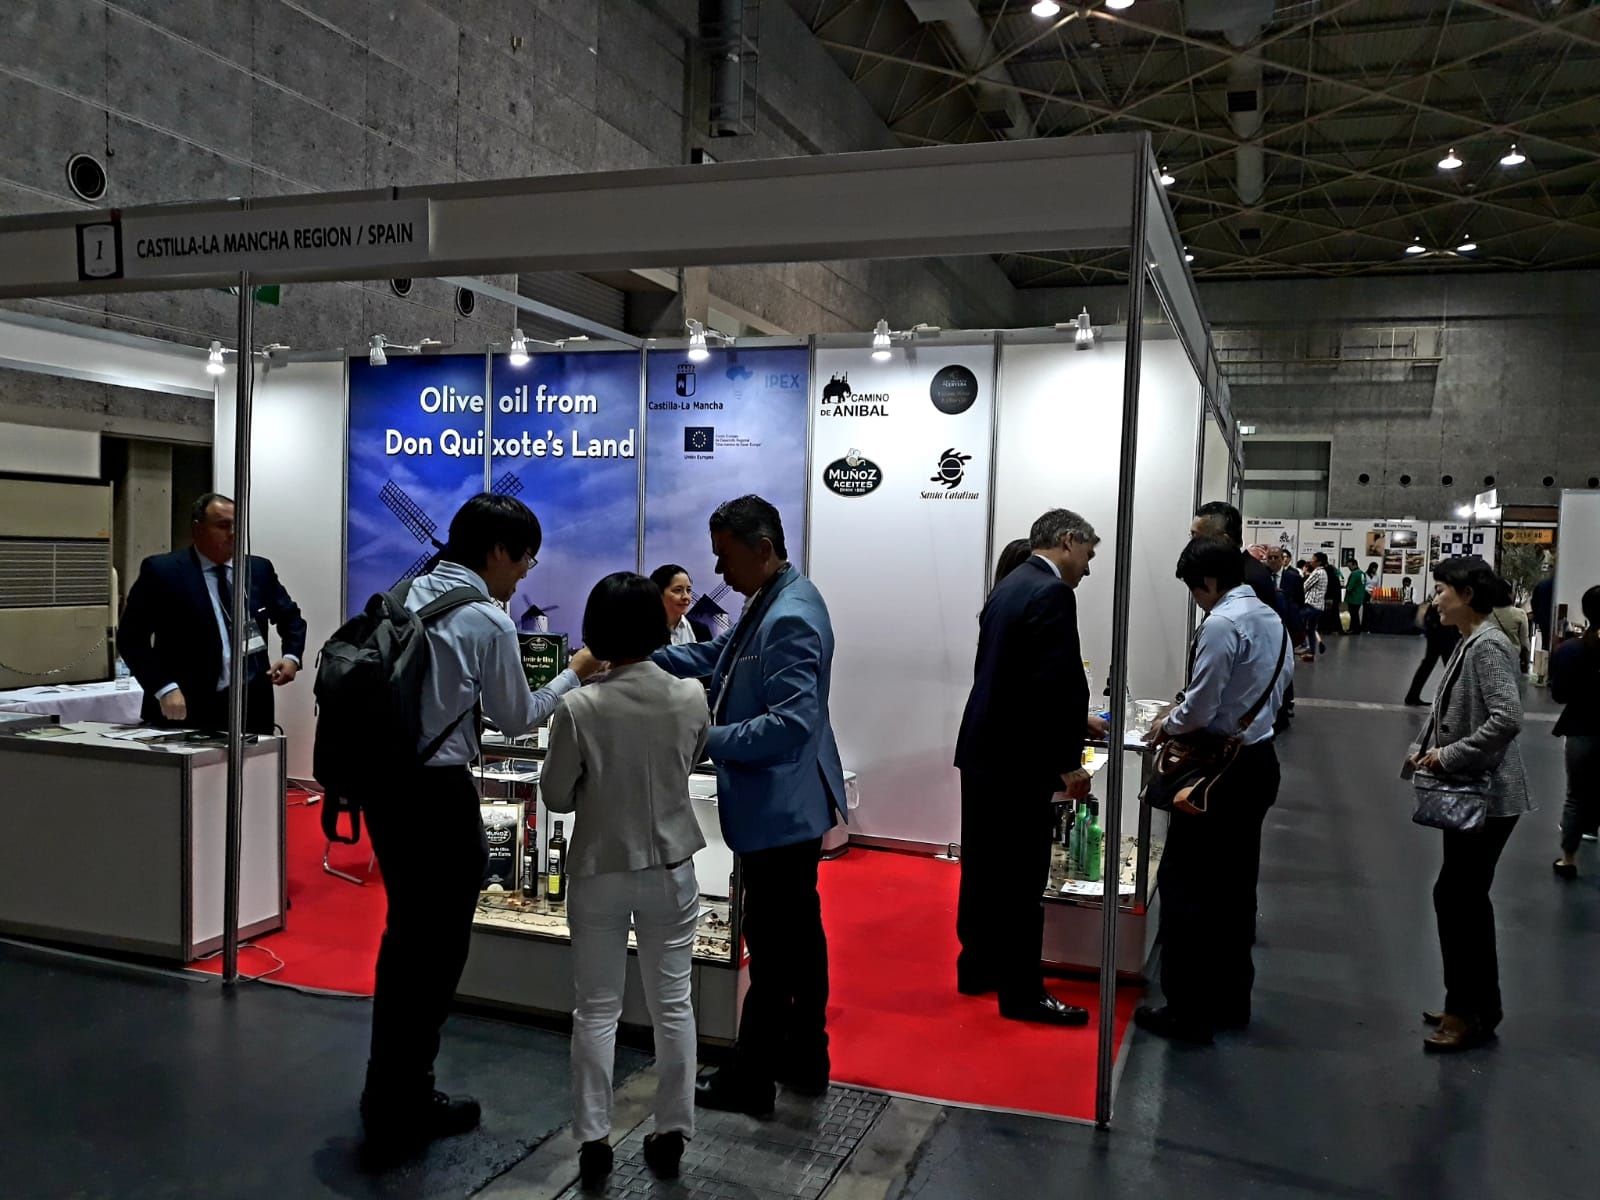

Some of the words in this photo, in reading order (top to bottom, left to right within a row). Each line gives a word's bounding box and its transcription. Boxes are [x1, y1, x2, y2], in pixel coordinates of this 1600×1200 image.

[137, 234, 220, 258] CASTILLA-LA
[223, 230, 290, 253] MANCHA
[294, 226, 352, 249] REGION
[356, 225, 363, 246] /
[368, 222, 413, 245] SPAIN
[765, 374, 800, 389] IPEX
[419, 385, 486, 414] Olive
[499, 384, 529, 414] oil
[535, 384, 598, 414] from
[850, 393, 890, 403] CAMINO
[648, 401, 691, 411] Castilla-La
[693, 401, 724, 411] Mancha
[820, 409, 831, 417] DE
[833, 405, 889, 417] ANIBAL
[385, 428, 433, 456] Don
[571, 428, 635, 458] Land
[828, 468, 878, 480] MUÑOZ
[920, 491, 943, 500] Santa
[944, 491, 979, 500] Catalina
